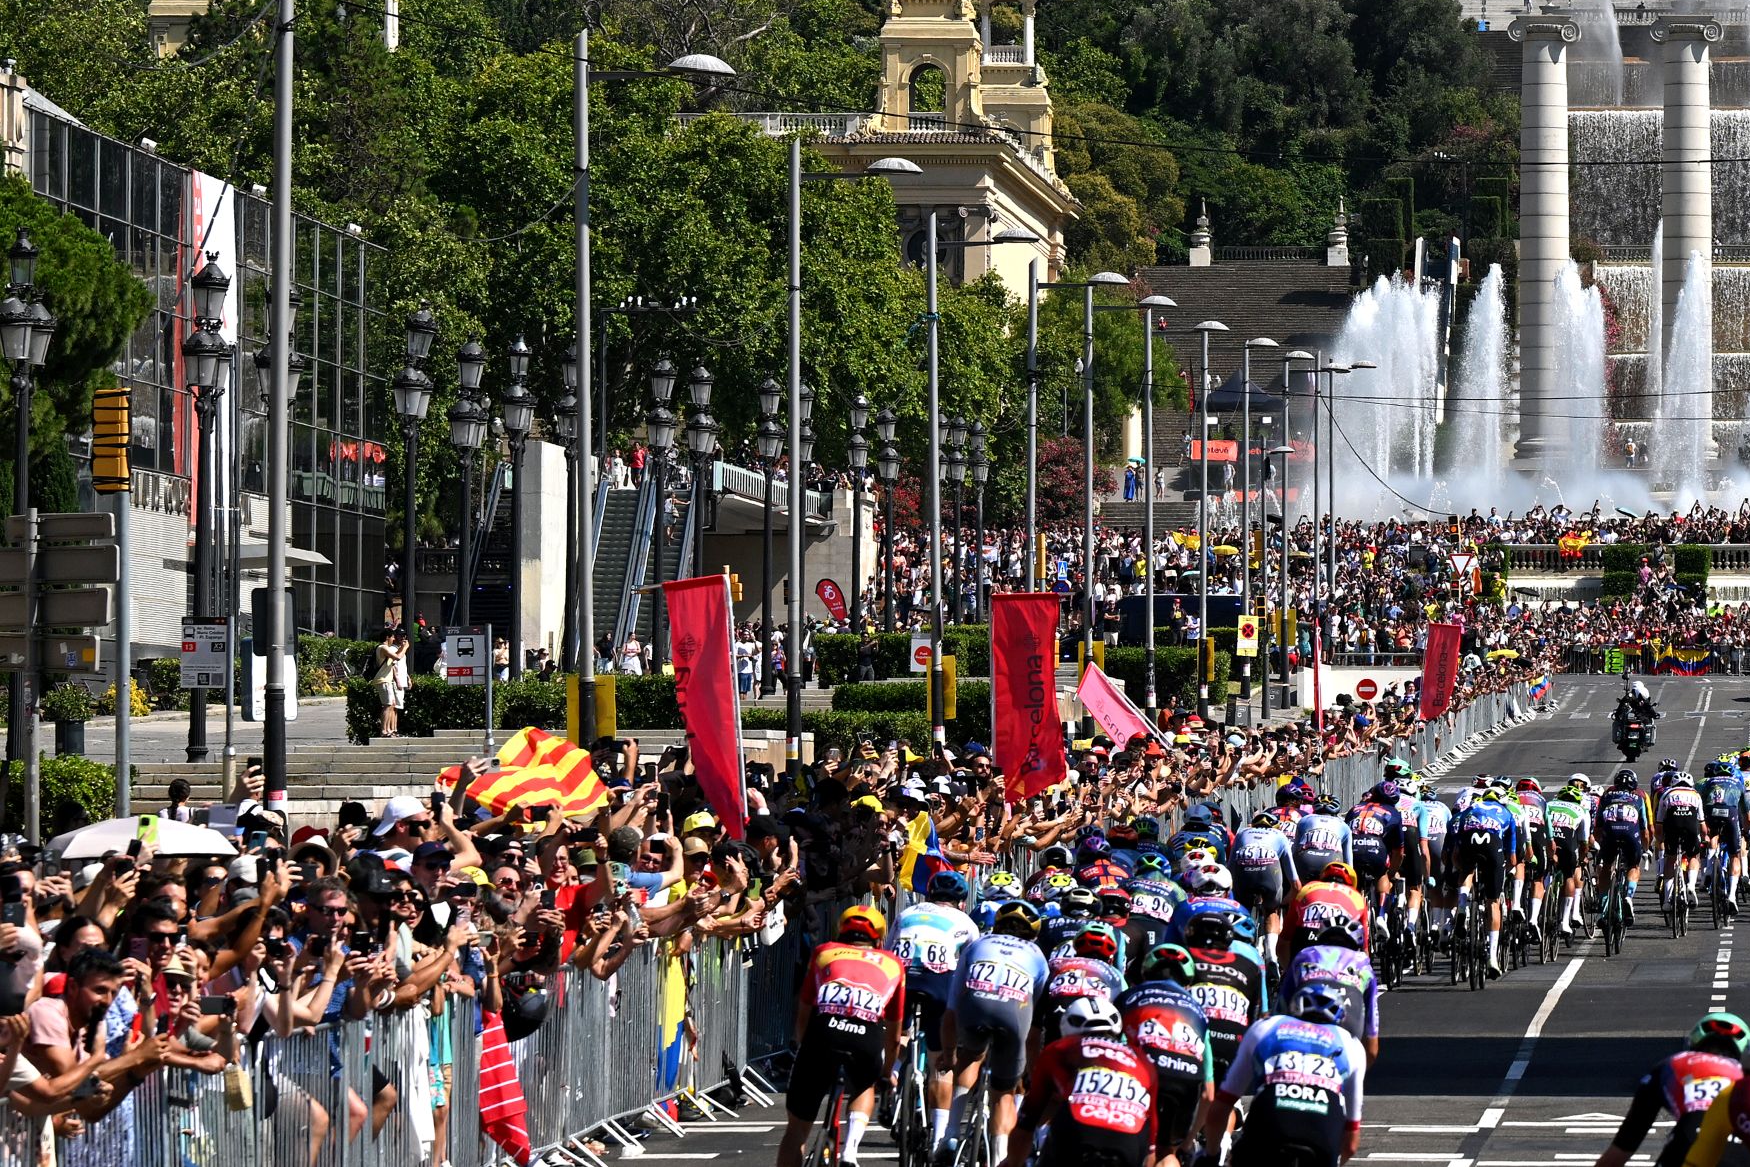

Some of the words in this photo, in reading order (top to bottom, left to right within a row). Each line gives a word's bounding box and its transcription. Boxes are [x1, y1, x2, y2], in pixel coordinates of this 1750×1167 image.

[1432, 652, 1448, 707] Barcelona
[1019, 654, 1045, 776] Barcelona
[927, 944, 947, 963] 68
[1195, 962, 1248, 985] UDOR
[820, 985, 851, 1006] 123
[1222, 990, 1248, 1016] 193
[1157, 1054, 1198, 1074] Shine
[1074, 1072, 1113, 1096] 152
[1275, 1084, 1330, 1103] BORA
[1693, 1080, 1722, 1101] 53
[1110, 1100, 1147, 1118] VELUX
